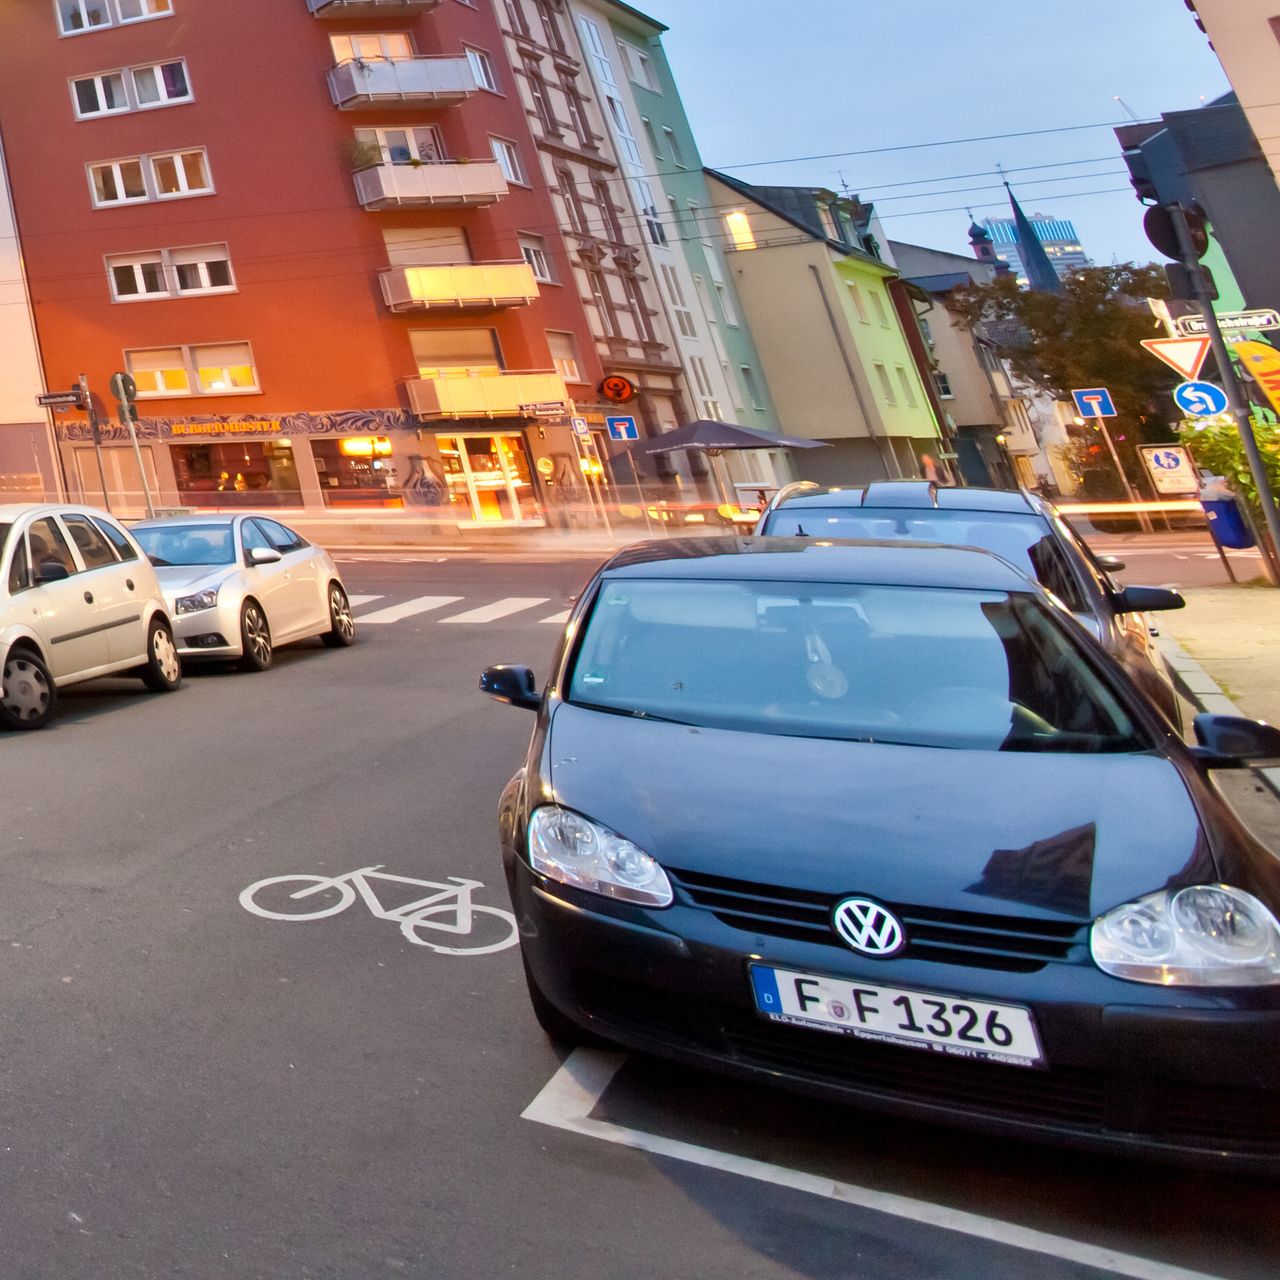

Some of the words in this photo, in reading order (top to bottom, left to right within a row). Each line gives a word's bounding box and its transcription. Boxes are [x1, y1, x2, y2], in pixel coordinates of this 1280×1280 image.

[794, 977, 820, 1012] F
[852, 988, 879, 1023] F
[892, 995, 1013, 1046] 1326
